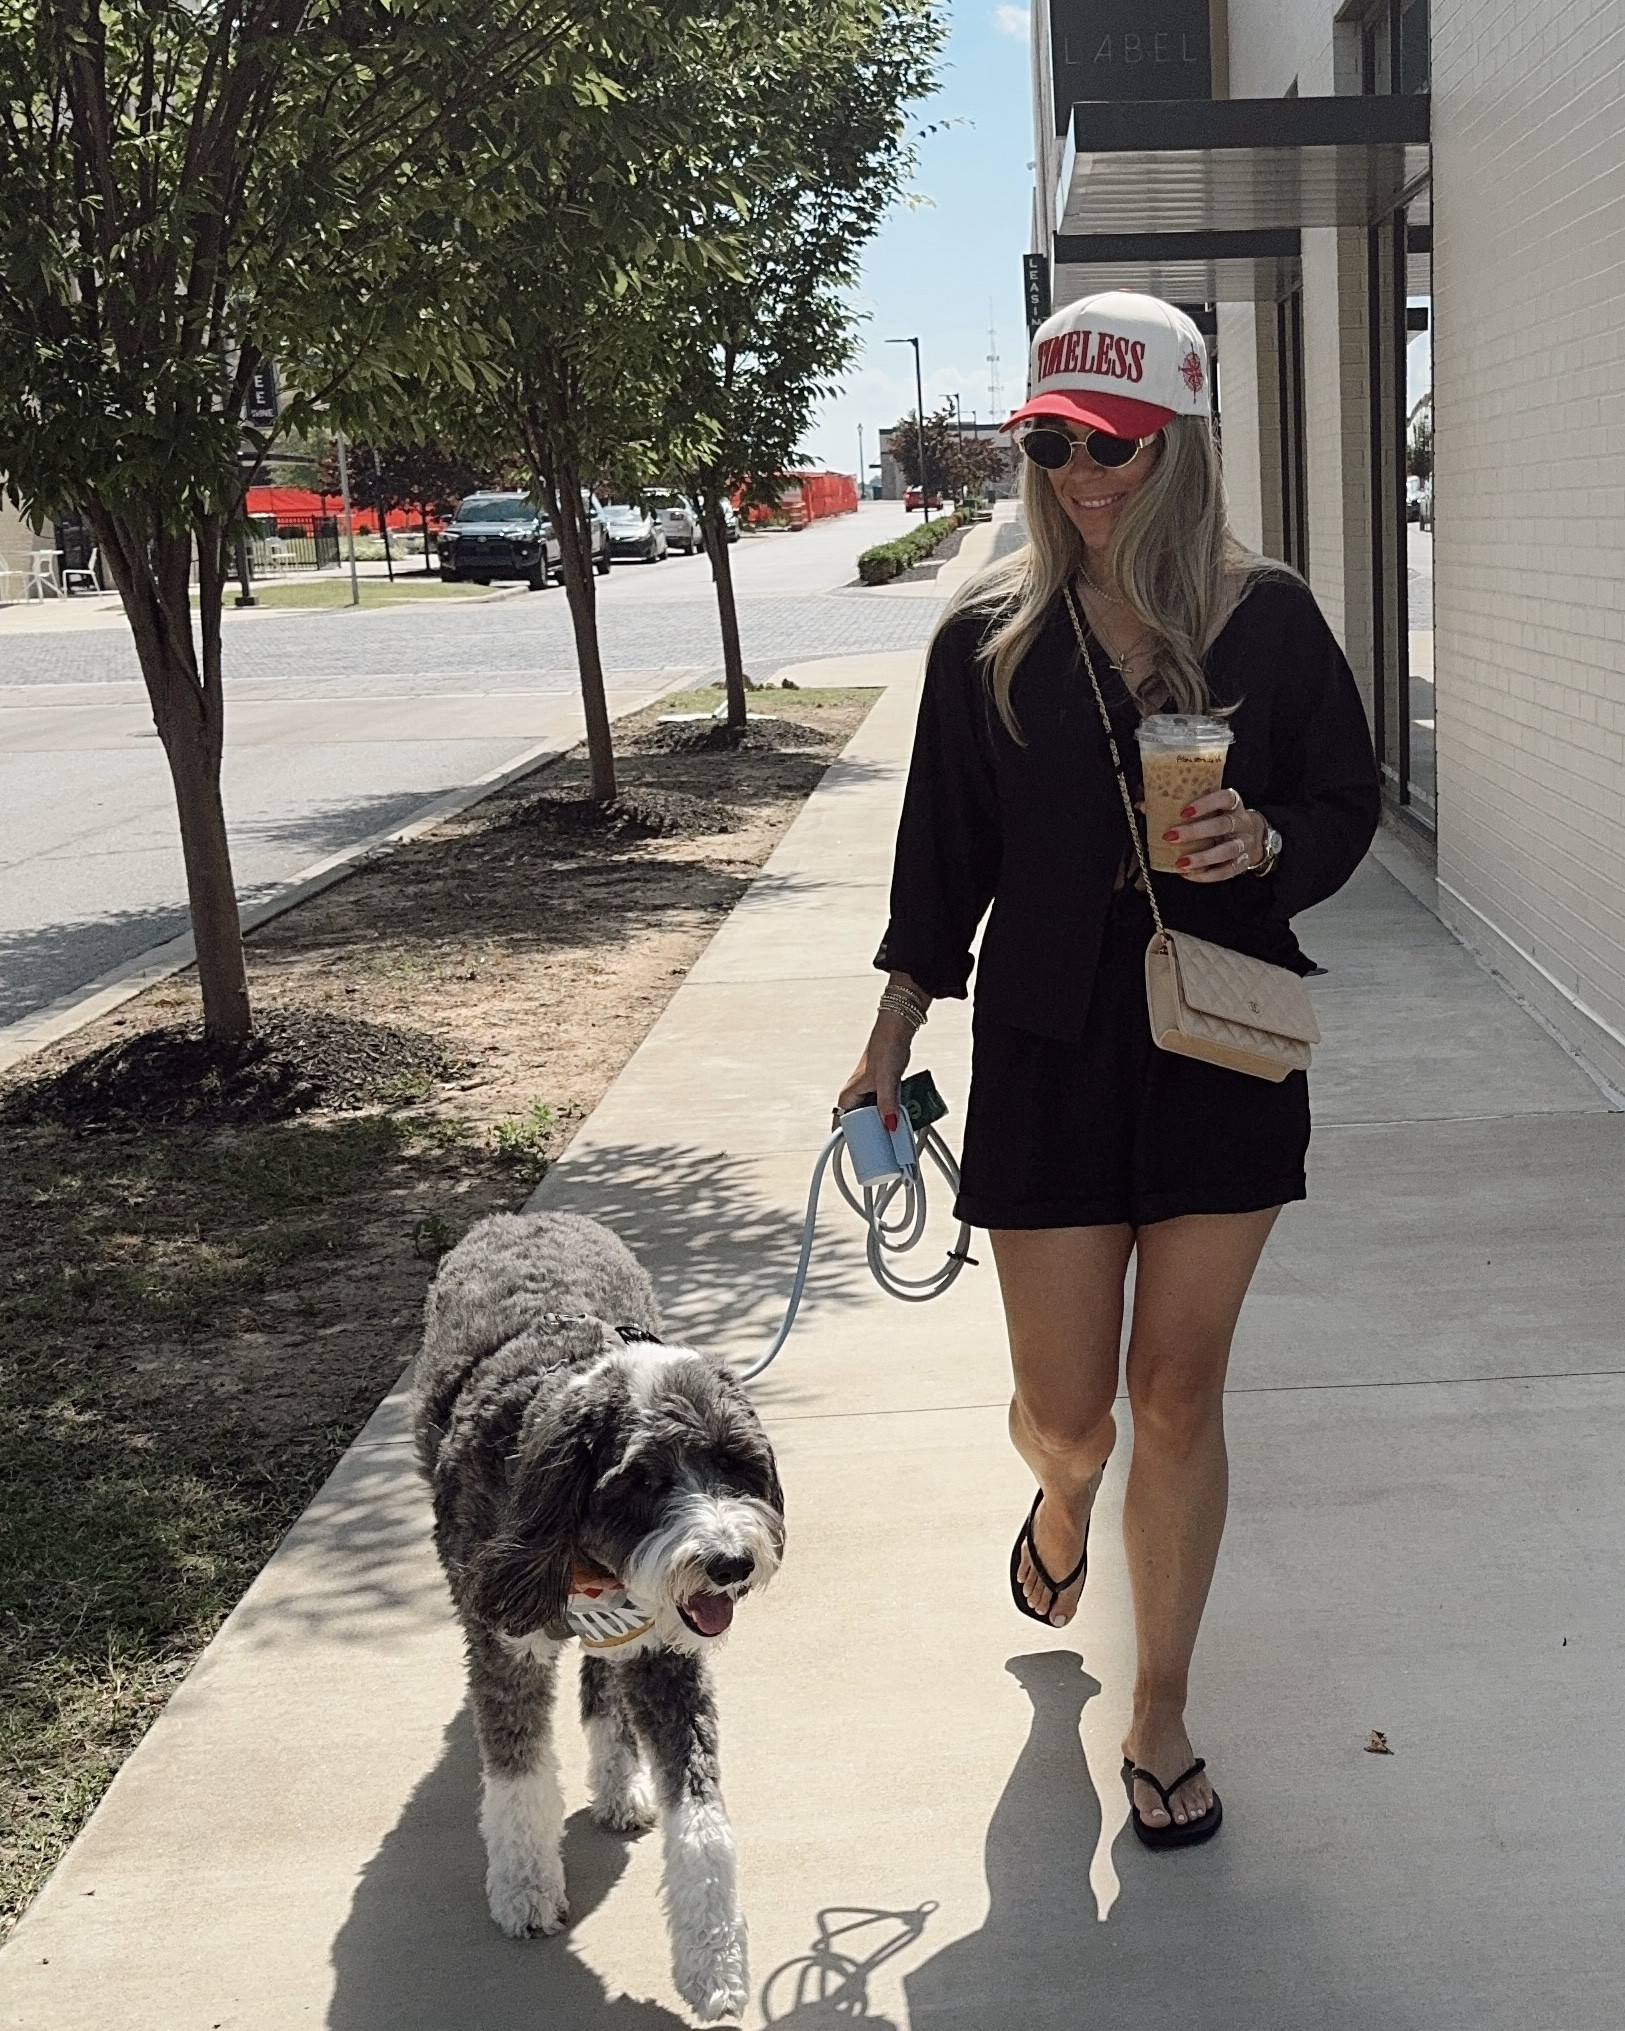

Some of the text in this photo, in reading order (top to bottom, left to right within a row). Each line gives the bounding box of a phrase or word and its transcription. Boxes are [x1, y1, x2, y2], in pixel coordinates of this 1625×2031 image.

[1064, 33, 1197, 65] LABEL
[1028, 258, 1042, 326] LEASIN
[1037, 330, 1146, 383] TIMELESS
